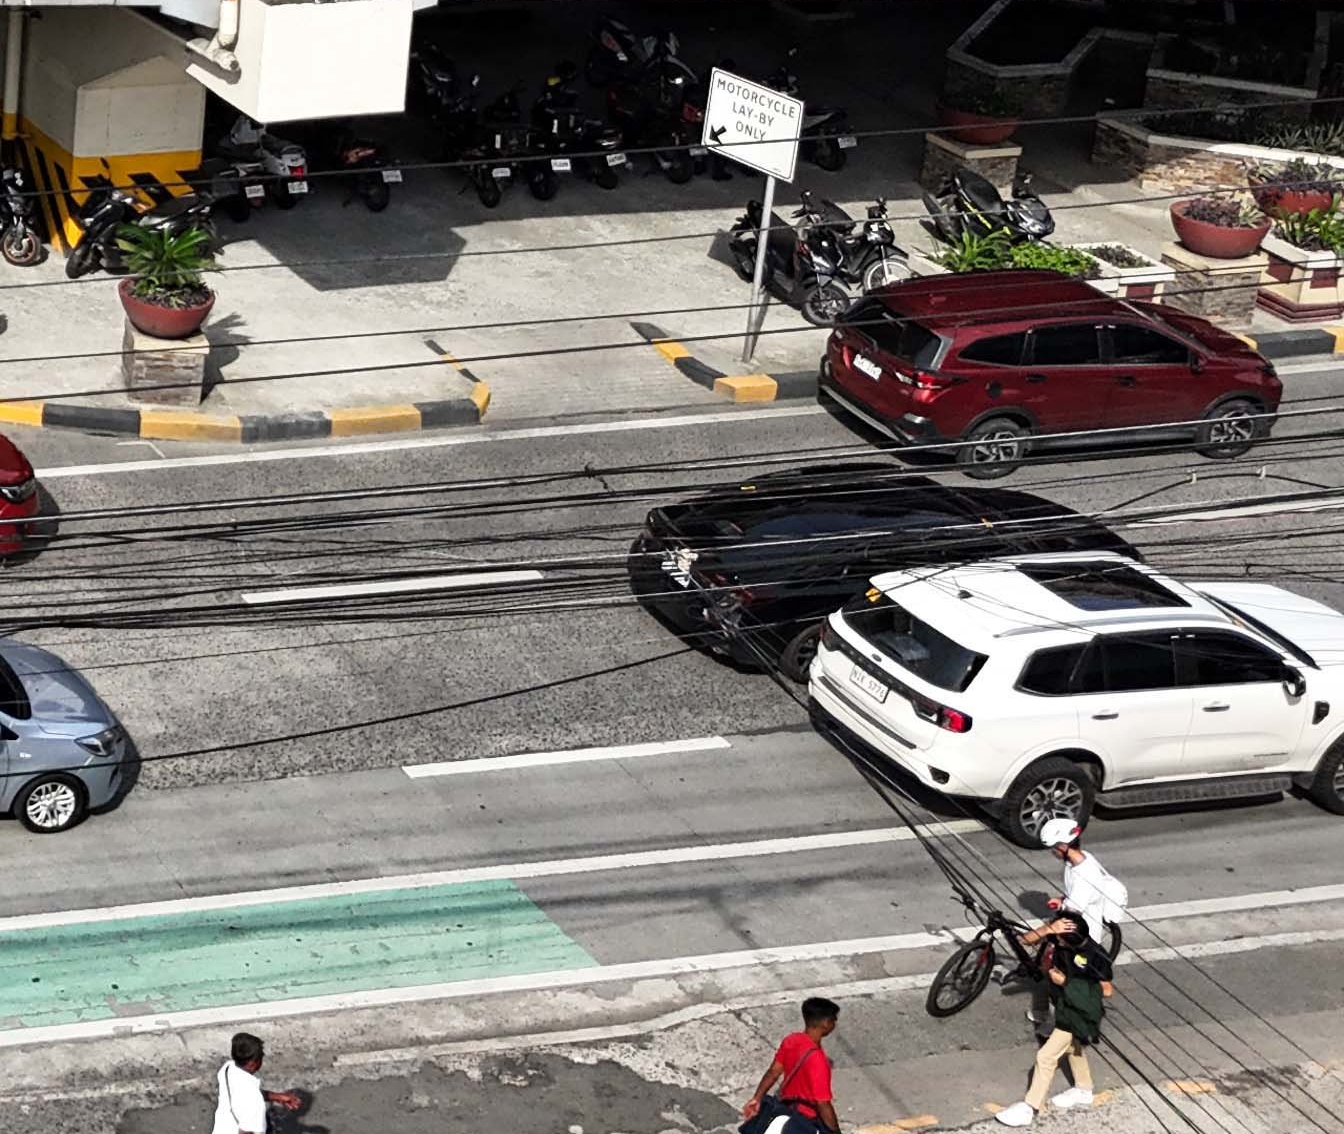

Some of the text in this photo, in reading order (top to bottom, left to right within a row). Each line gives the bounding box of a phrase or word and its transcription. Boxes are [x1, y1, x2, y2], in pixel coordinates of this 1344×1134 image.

[716, 78, 796, 119] MOTORCYCLE
[732, 101, 775, 127] LAY-BY
[735, 121, 766, 141] ONLY
